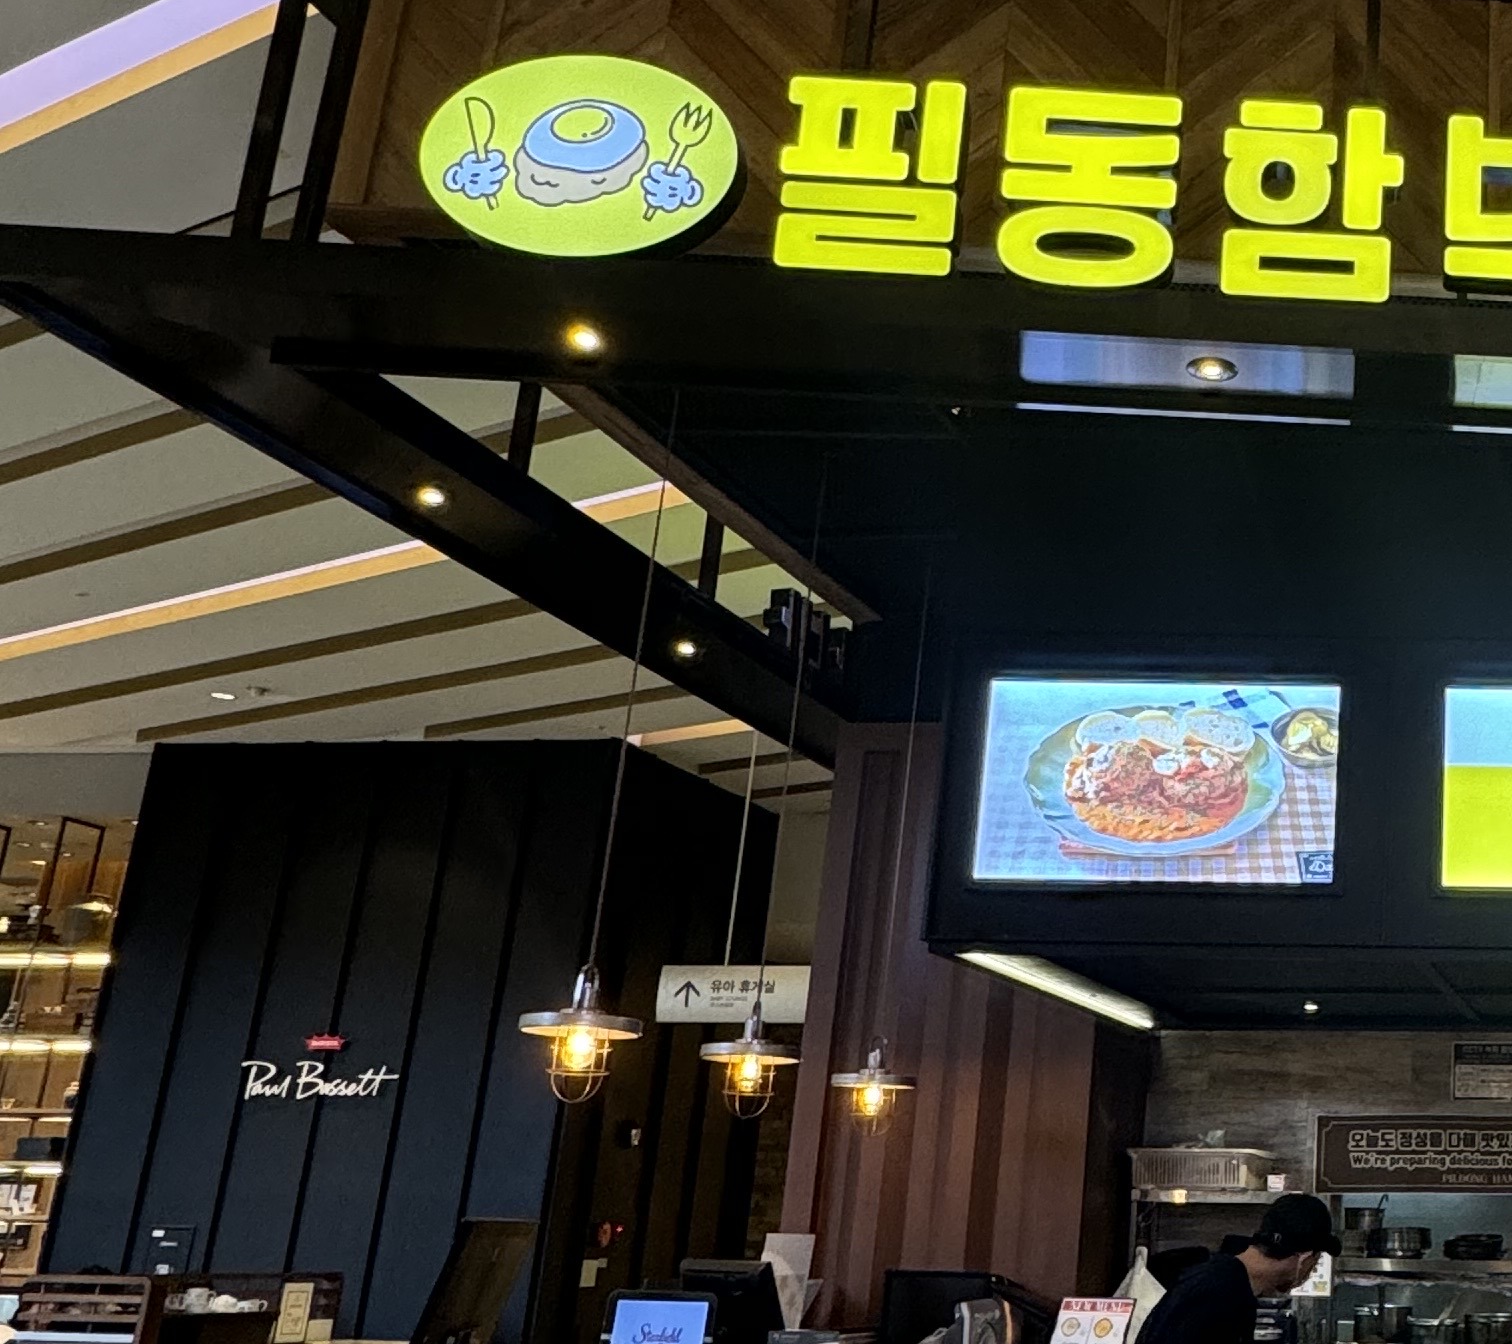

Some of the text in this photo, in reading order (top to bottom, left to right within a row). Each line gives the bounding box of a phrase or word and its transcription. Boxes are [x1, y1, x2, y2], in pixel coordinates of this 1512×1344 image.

[710, 979, 735, 994] 유아
[241, 1060, 292, 1100] Paul
[1349, 1131, 1398, 1149] 오늘도
[1399, 1131, 1445, 1149] 정성을
[1446, 1131, 1479, 1149] 다해
[1350, 1154, 1388, 1168] We're
[1389, 1155, 1447, 1170] preparing
[1449, 1154, 1501, 1167] delicious
